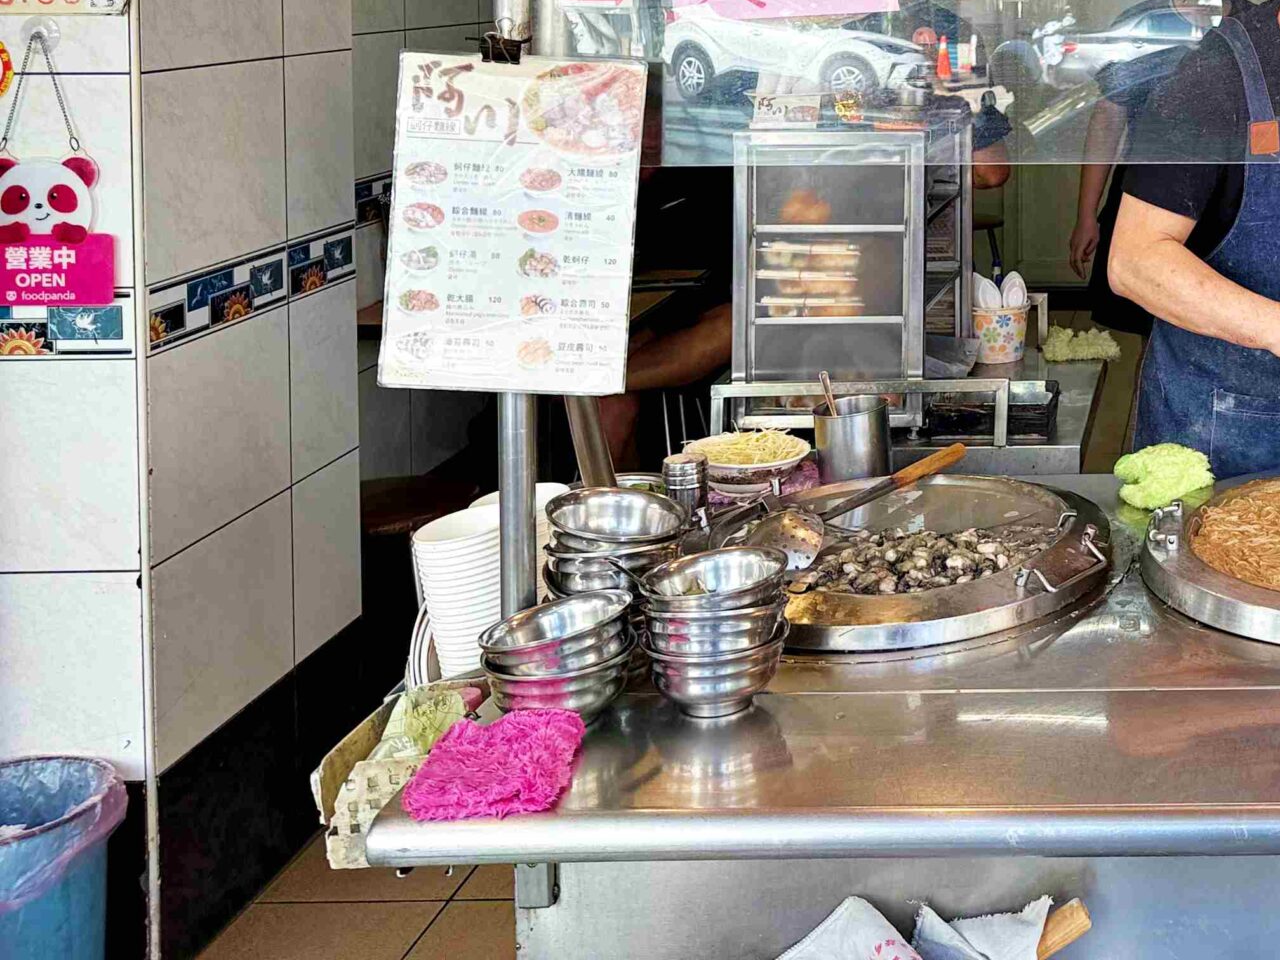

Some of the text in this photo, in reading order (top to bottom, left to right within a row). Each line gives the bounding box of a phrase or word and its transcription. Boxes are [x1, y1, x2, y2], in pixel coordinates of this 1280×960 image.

[5, 246, 76, 271] 營業中
[15, 273, 66, 287] OPEN
[21, 290, 76, 302] foodpanda
